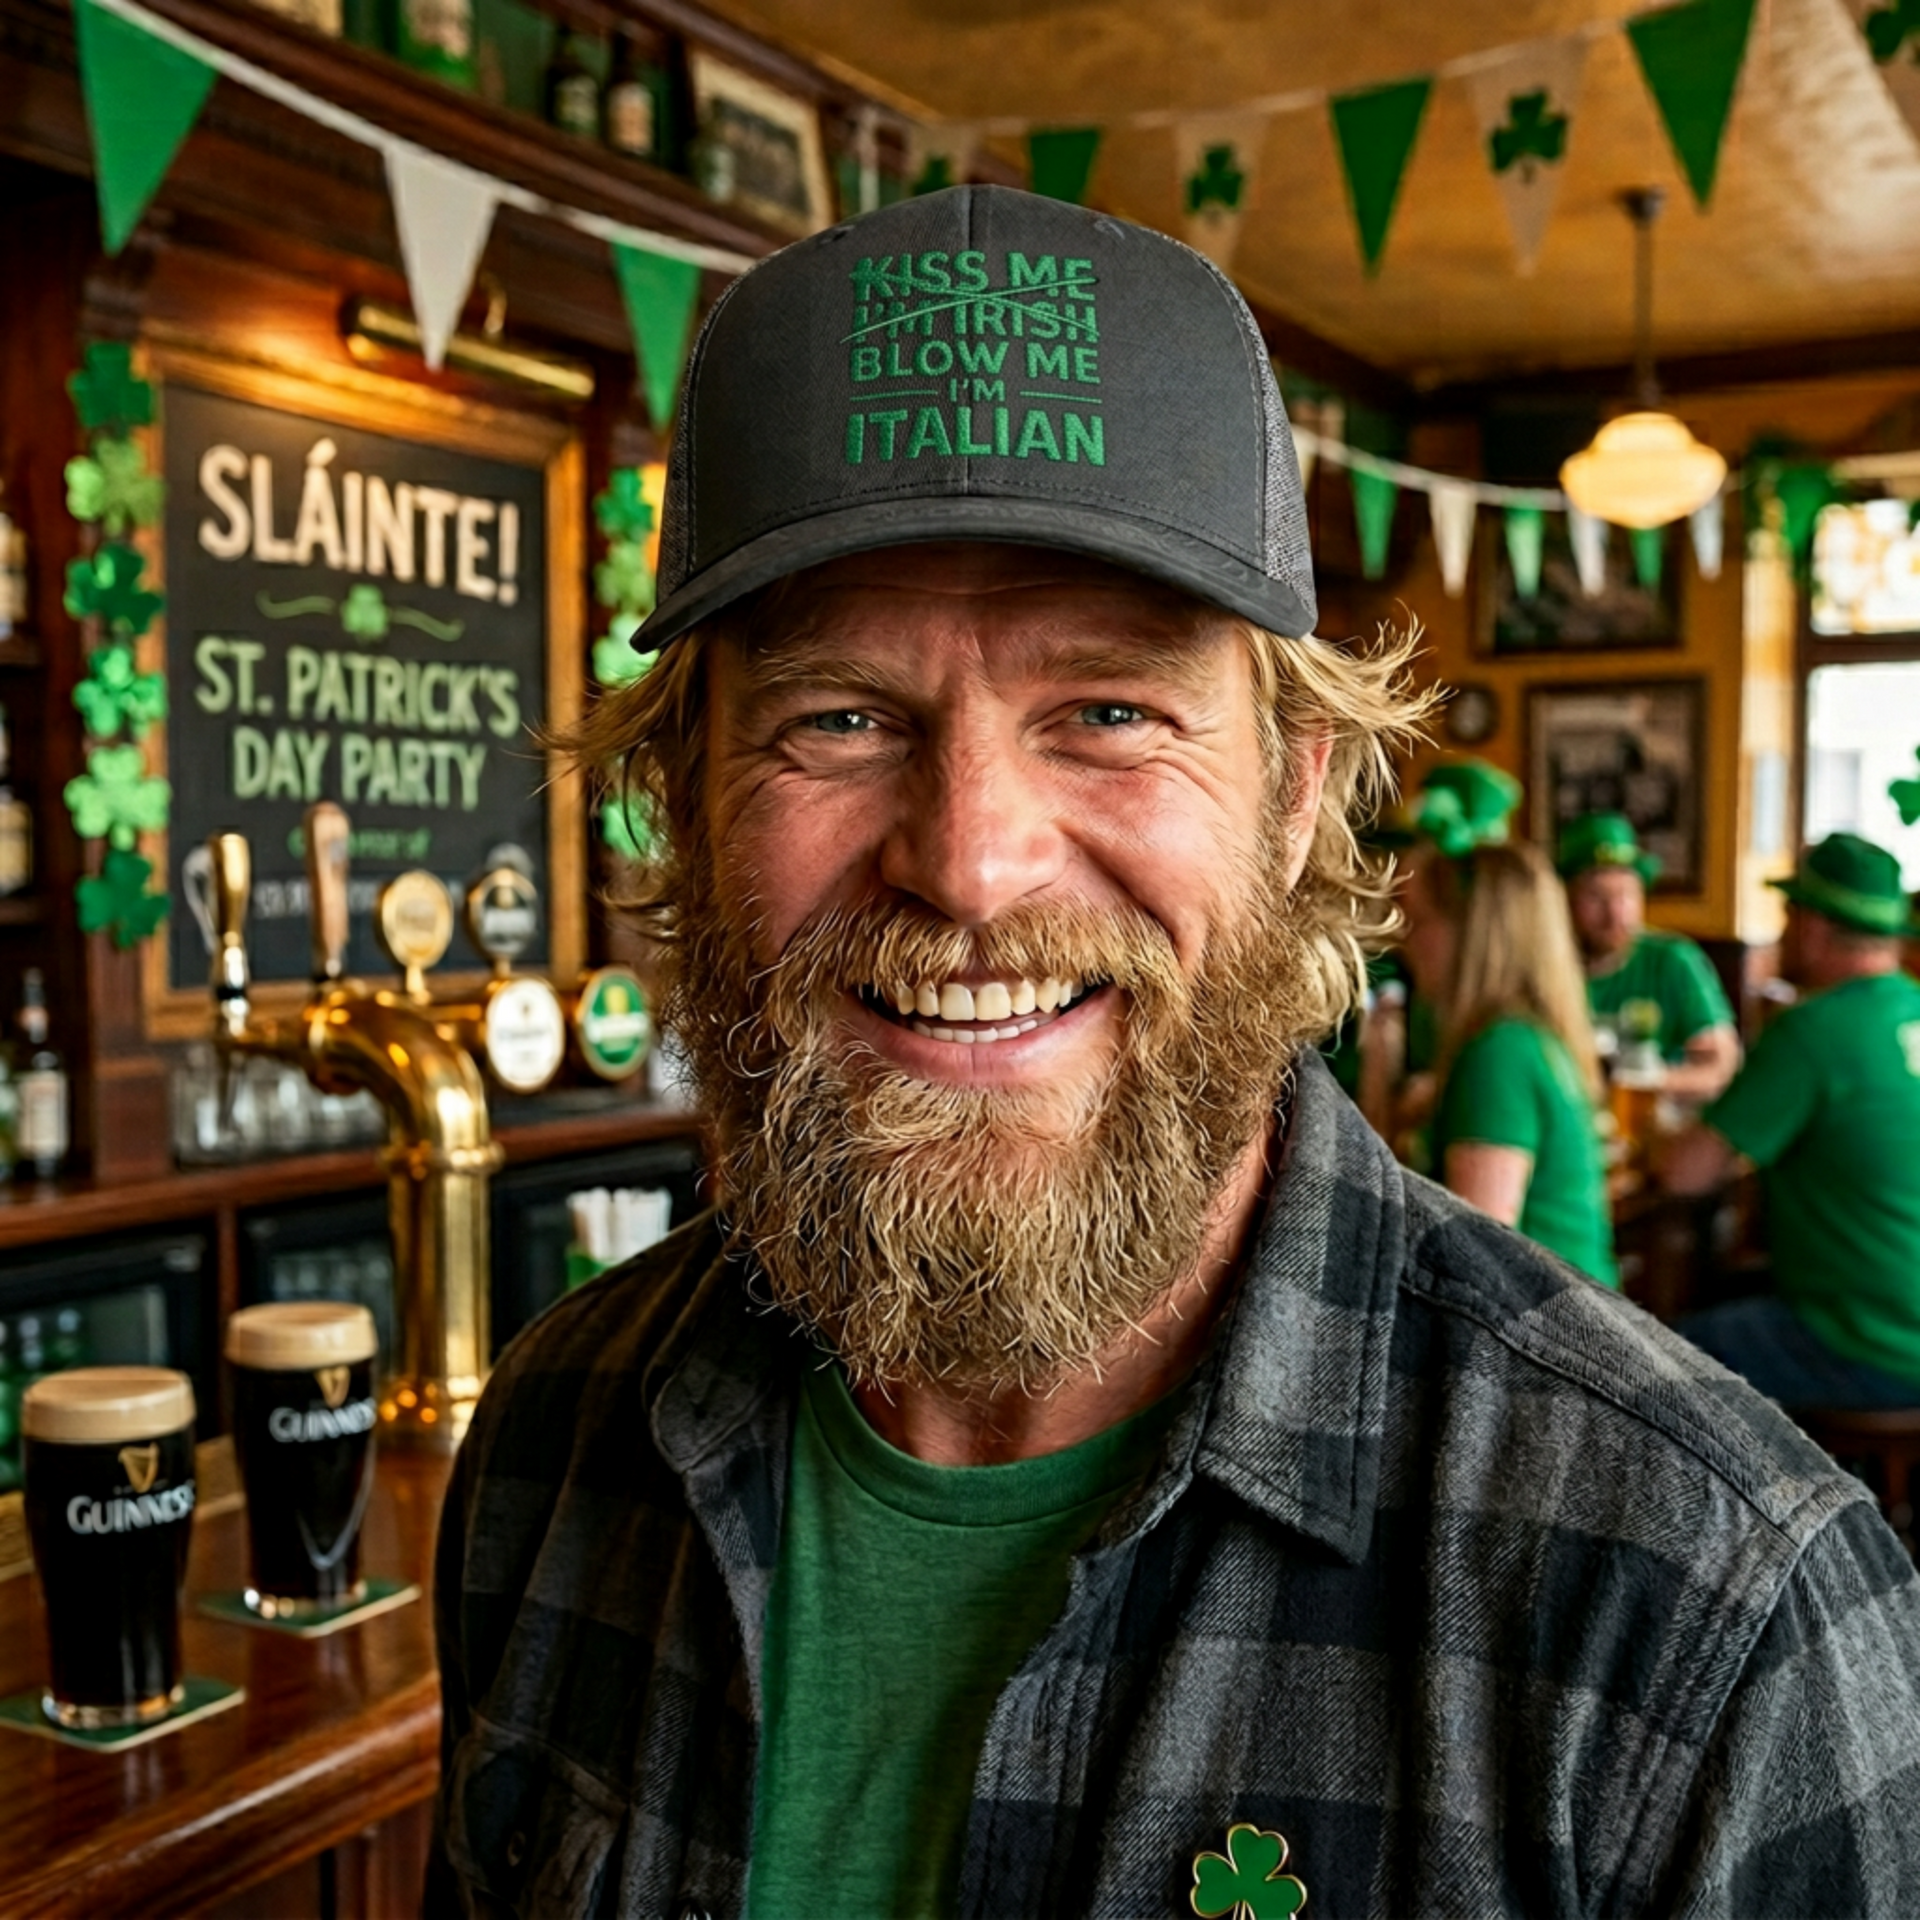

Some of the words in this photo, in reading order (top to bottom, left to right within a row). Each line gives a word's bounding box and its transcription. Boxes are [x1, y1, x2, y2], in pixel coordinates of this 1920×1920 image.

[851, 250, 989, 300] KISS
[1008, 252, 1095, 301] ME
[953, 300, 1099, 343] IRISH
[851, 340, 1009, 382] BLOW
[1026, 342, 1101, 384] ME
[949, 378, 1006, 402] I'M
[846, 407, 1106, 466] ITALIAN
[200, 438, 520, 606] SLÁINTE!
[195, 636, 274, 714] ST.
[286, 645, 521, 737] PATRICK'S
[233, 727, 331, 799] DAY
[340, 735, 487, 811] PARTY
